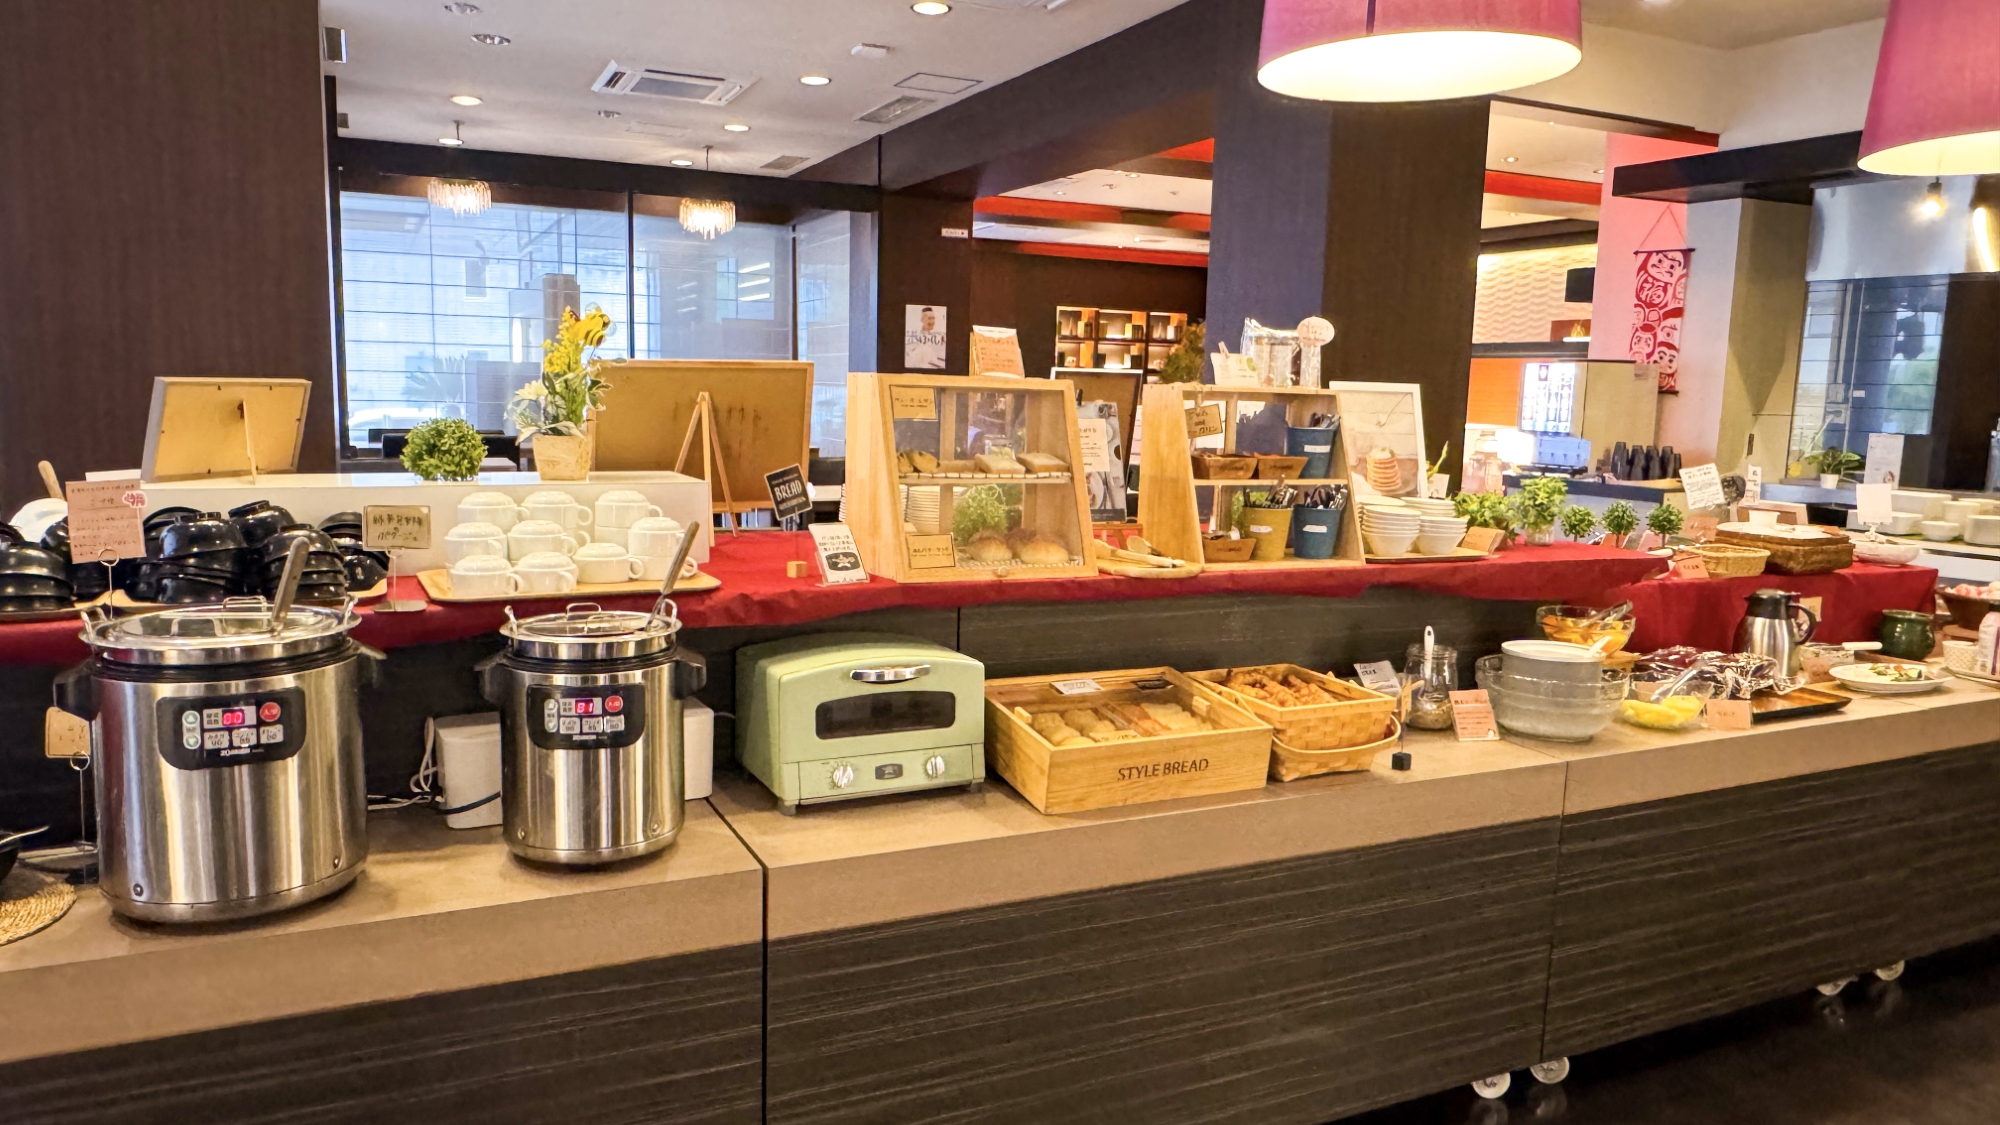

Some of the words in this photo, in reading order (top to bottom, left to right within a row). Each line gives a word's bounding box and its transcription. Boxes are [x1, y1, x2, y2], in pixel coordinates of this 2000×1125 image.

[774, 479, 803, 502] BREAD
[1117, 763, 1161, 782] STYLE
[1162, 758, 1210, 776] BREAD
